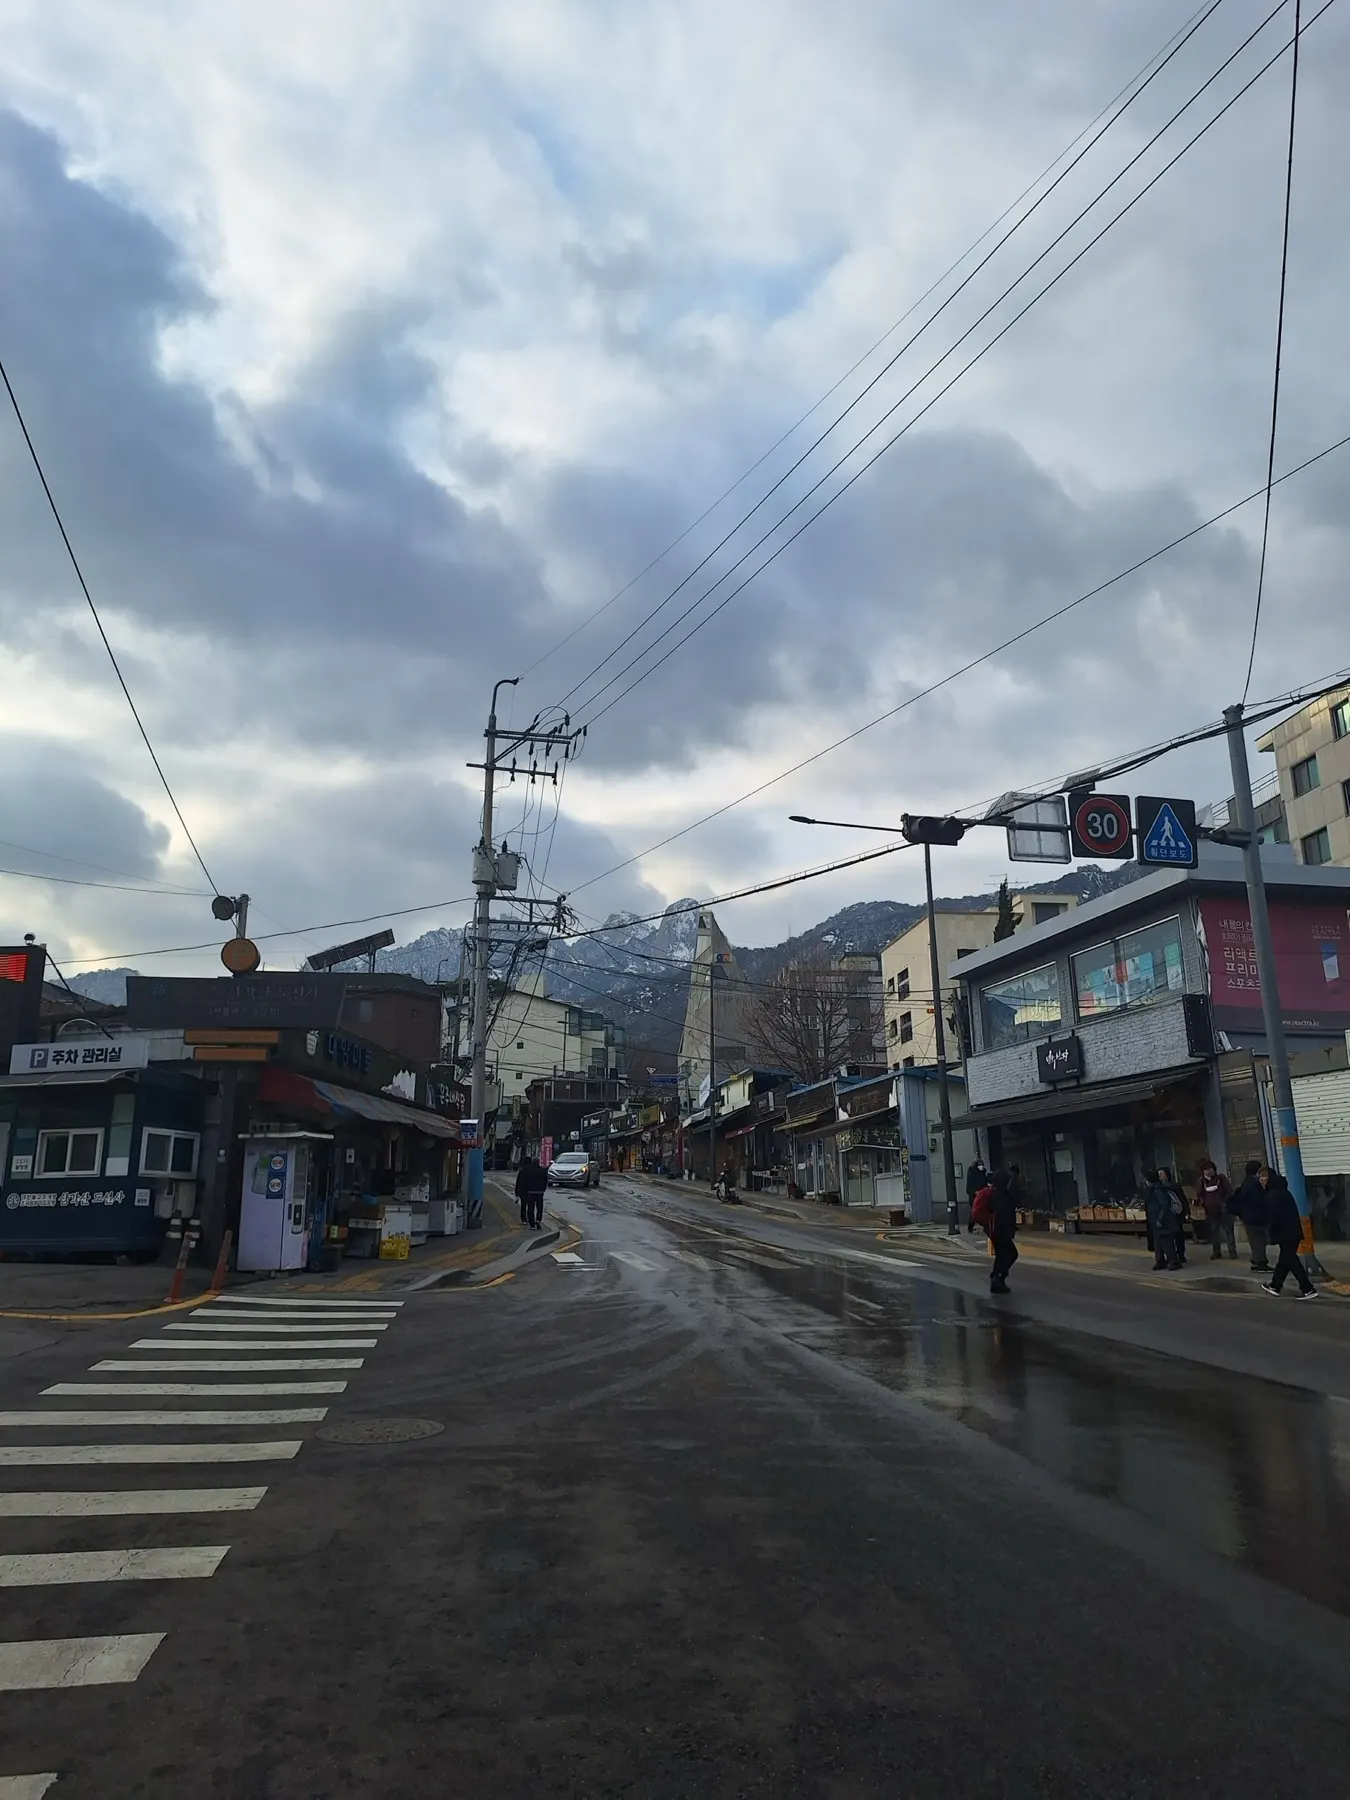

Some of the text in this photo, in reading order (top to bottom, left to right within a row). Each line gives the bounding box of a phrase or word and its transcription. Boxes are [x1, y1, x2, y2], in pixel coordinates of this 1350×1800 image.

[1087, 812, 1118, 840] 30
[1151, 847, 1188, 859] 횡단보도
[52, 1049, 79, 1066] 주차
[82, 1047, 122, 1064] 관리실
[91, 1190, 125, 1206] 도선사
